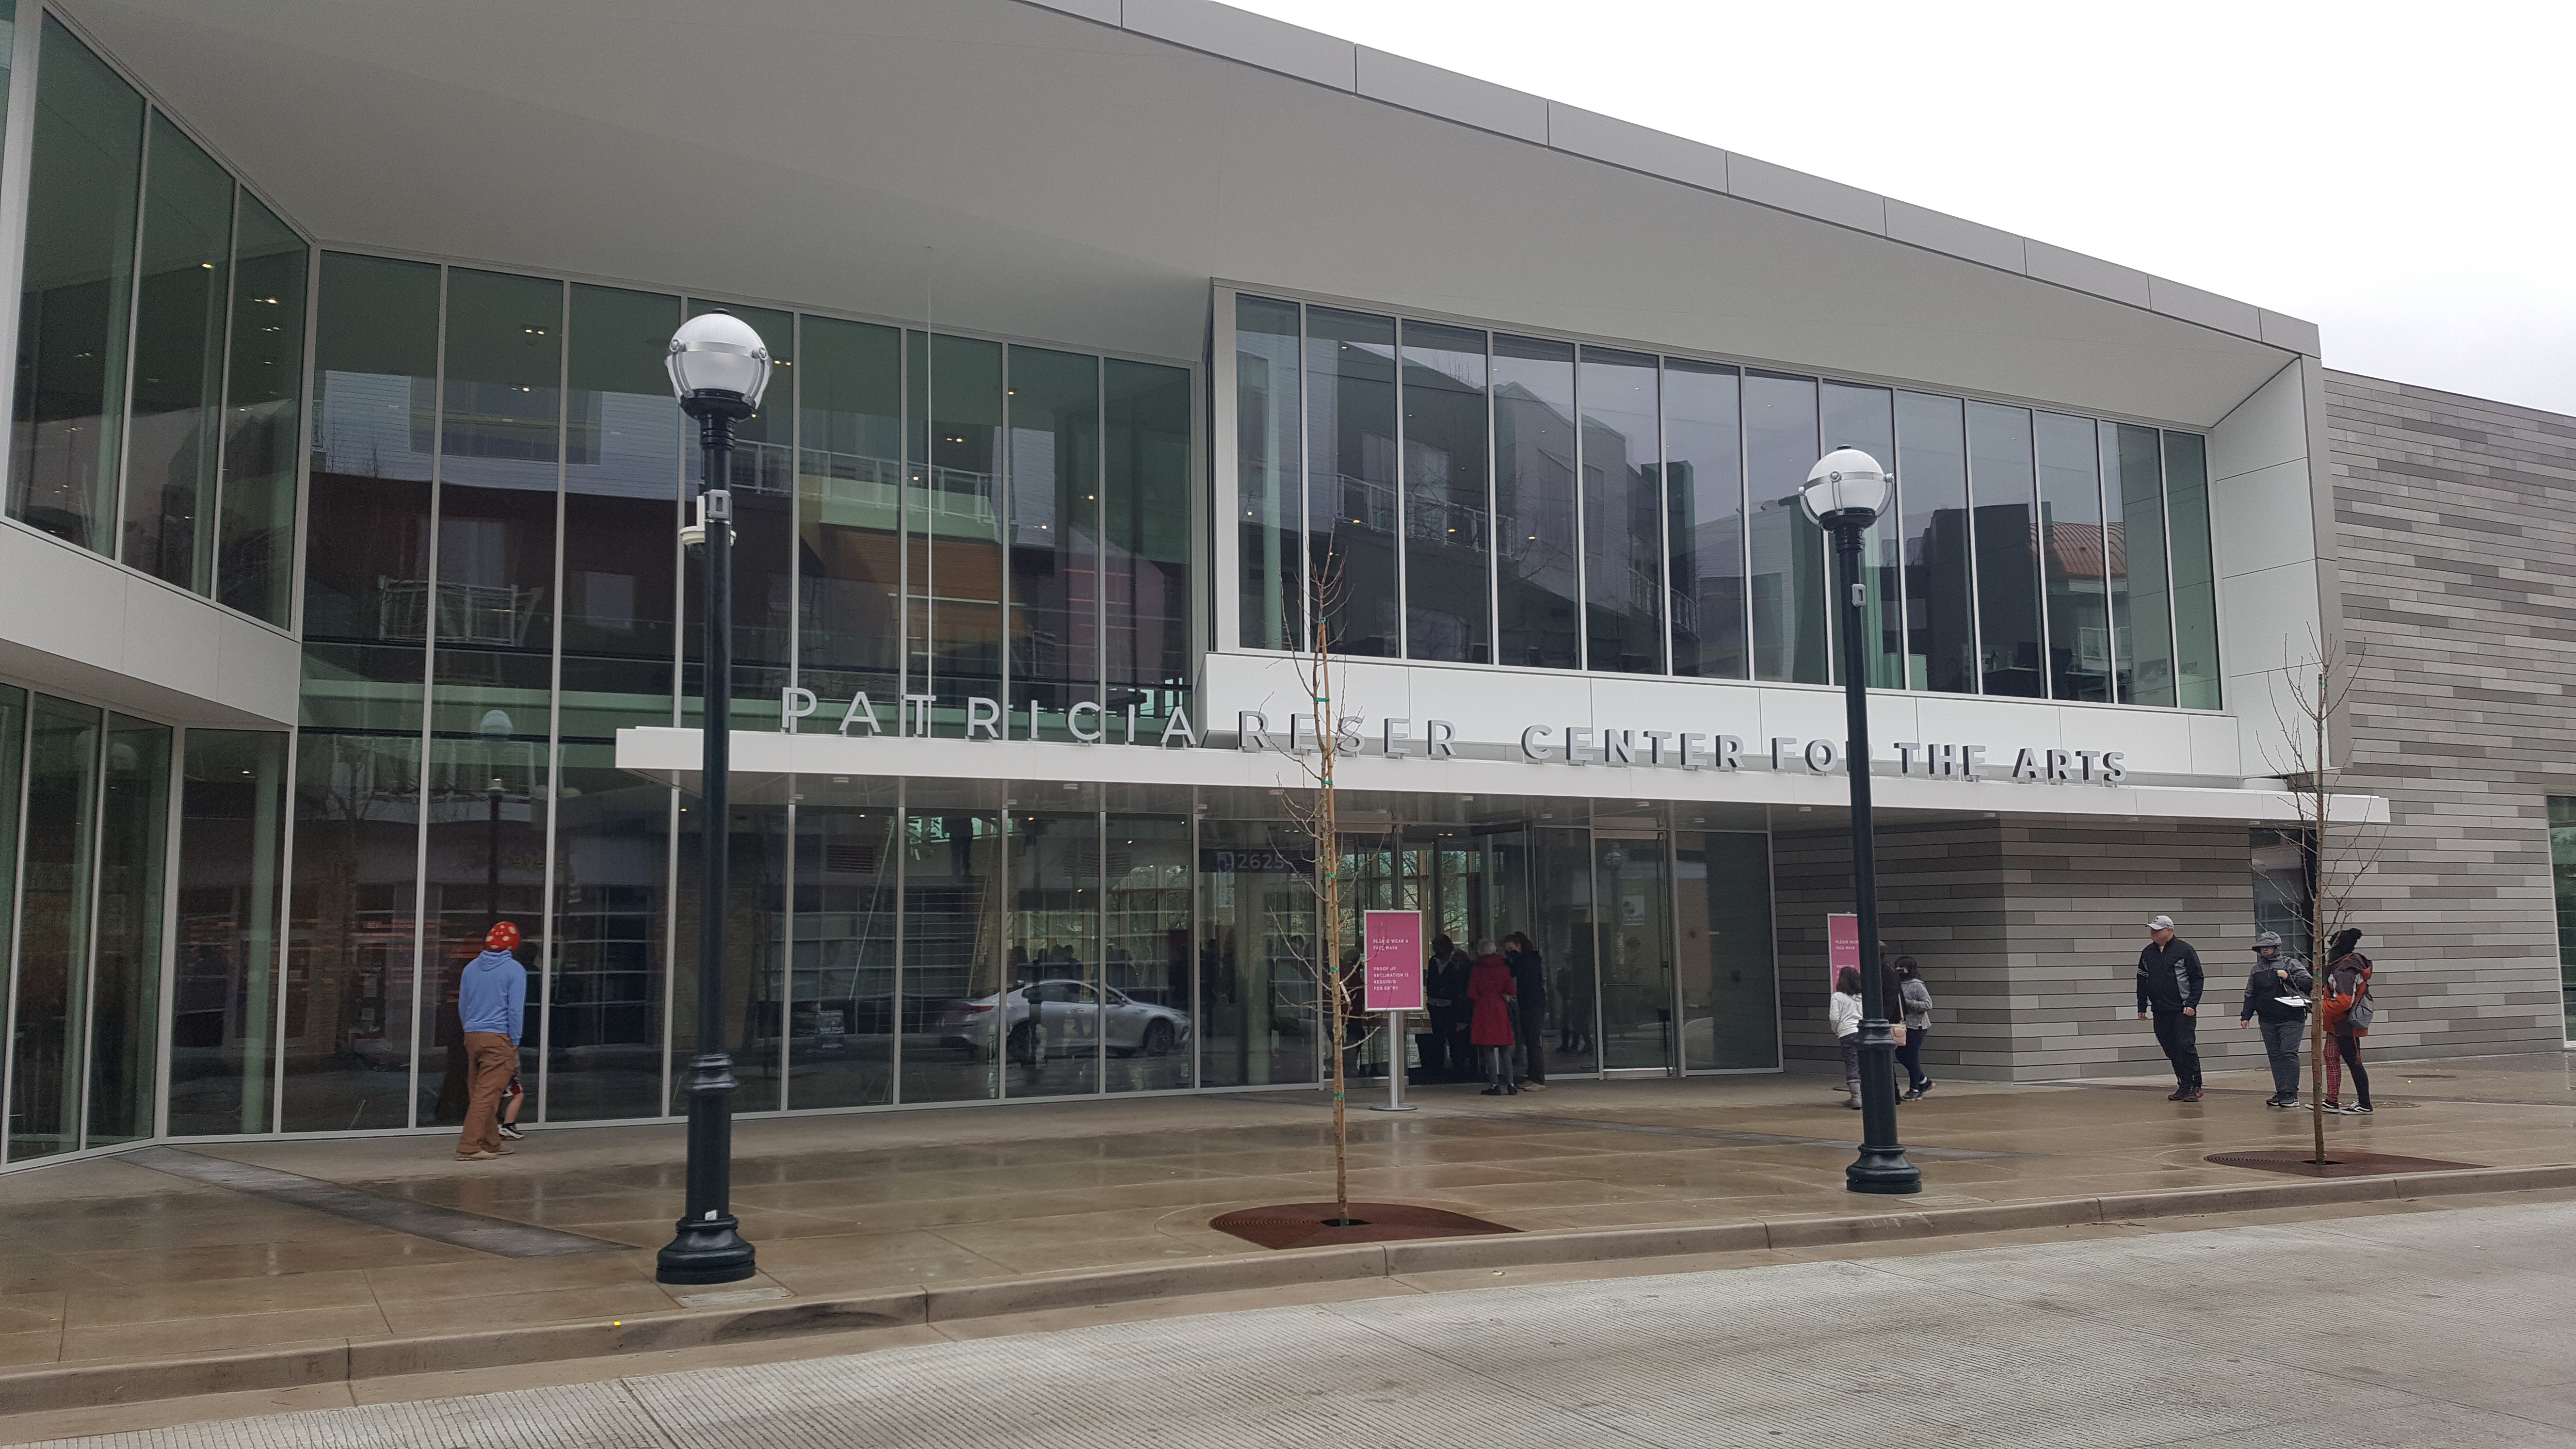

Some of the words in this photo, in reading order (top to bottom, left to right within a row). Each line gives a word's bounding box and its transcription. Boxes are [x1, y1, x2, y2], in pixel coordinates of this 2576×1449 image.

[781, 687, 1197, 745] PATRICIA
[1239, 710, 1456, 756] RESER
[1521, 724, 1745, 769] CENTER
[1771, 737, 1874, 773] FO
[1893, 742, 1988, 777] THE
[2012, 748, 2127, 783] ARTS
[1237, 853, 1285, 869] 2625
